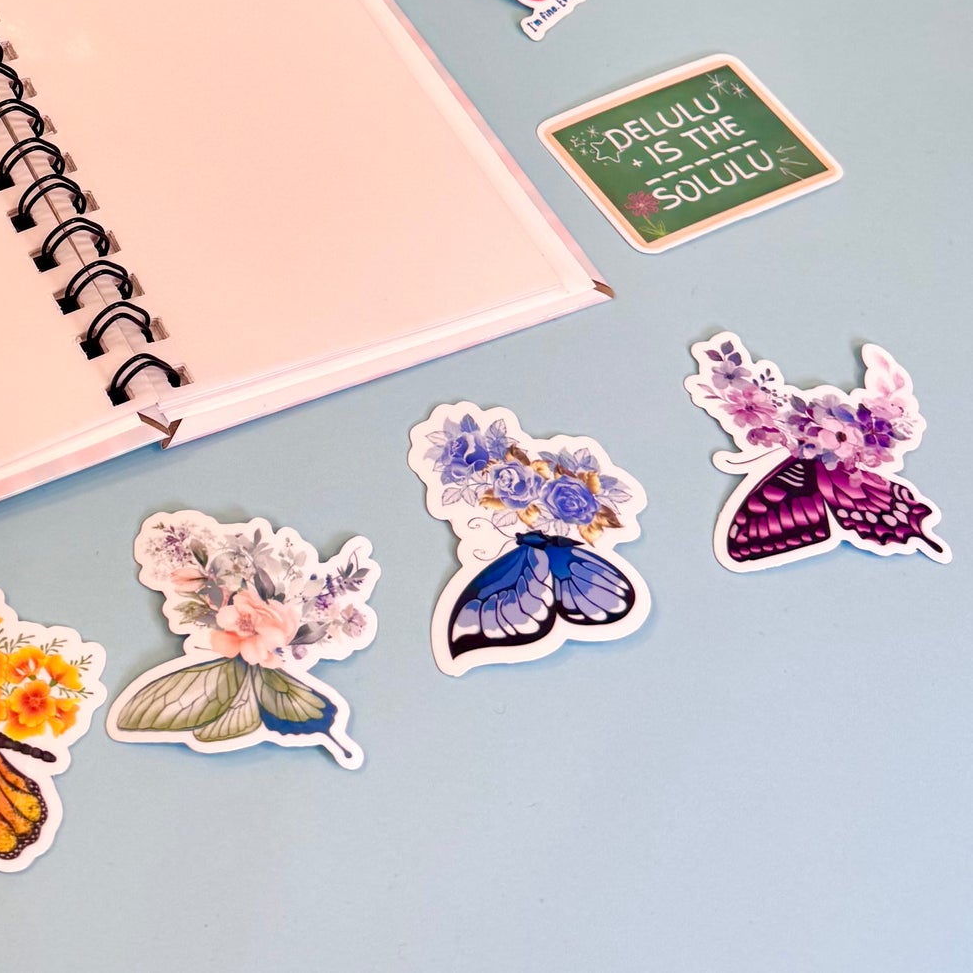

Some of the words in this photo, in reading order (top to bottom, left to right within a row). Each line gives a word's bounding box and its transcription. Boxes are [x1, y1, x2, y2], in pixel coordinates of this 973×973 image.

[527, 19, 543, 32] I'm
[539, 6, 560, 21] fine.
[603, 92, 721, 151] DELULU
[644, 140, 684, 166] IS
[680, 115, 745, 150] THE
[651, 148, 775, 211] SOLULU
